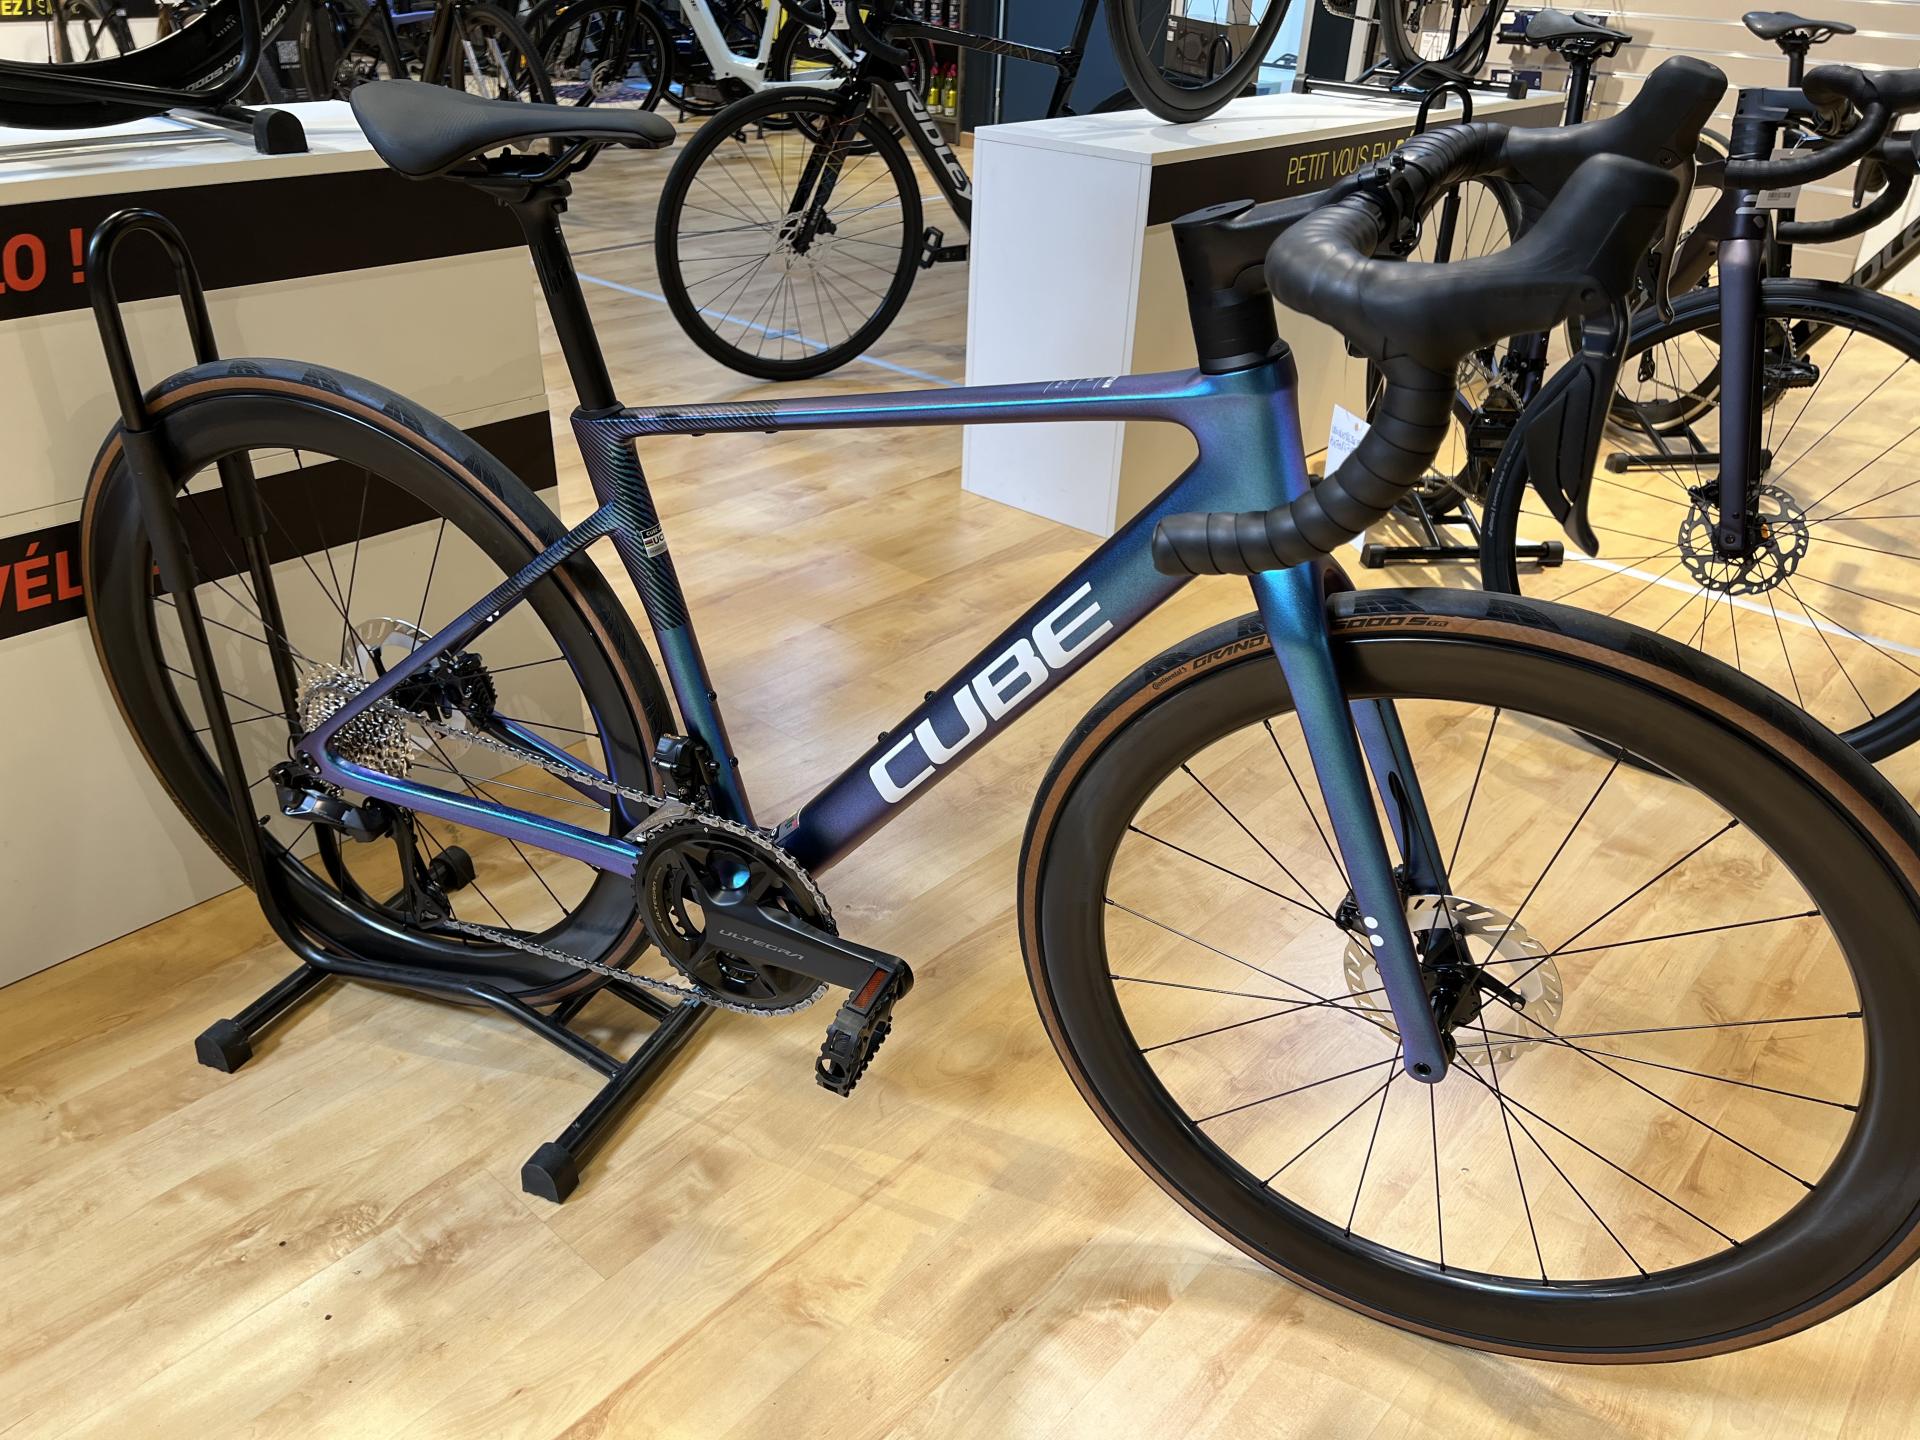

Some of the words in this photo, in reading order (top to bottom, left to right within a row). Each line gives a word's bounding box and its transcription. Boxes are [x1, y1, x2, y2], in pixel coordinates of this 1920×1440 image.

[894, 81, 973, 201] RIDLEY
[1286, 151, 1330, 186] PETIT
[1332, 144, 1369, 177] VOUS
[69, 227, 86, 284] !
[0, 541, 84, 612] ÉL
[1192, 634, 1267, 671] GRAND
[868, 580, 1115, 804] CUBE
[719, 929, 805, 960] ULTEGRA
